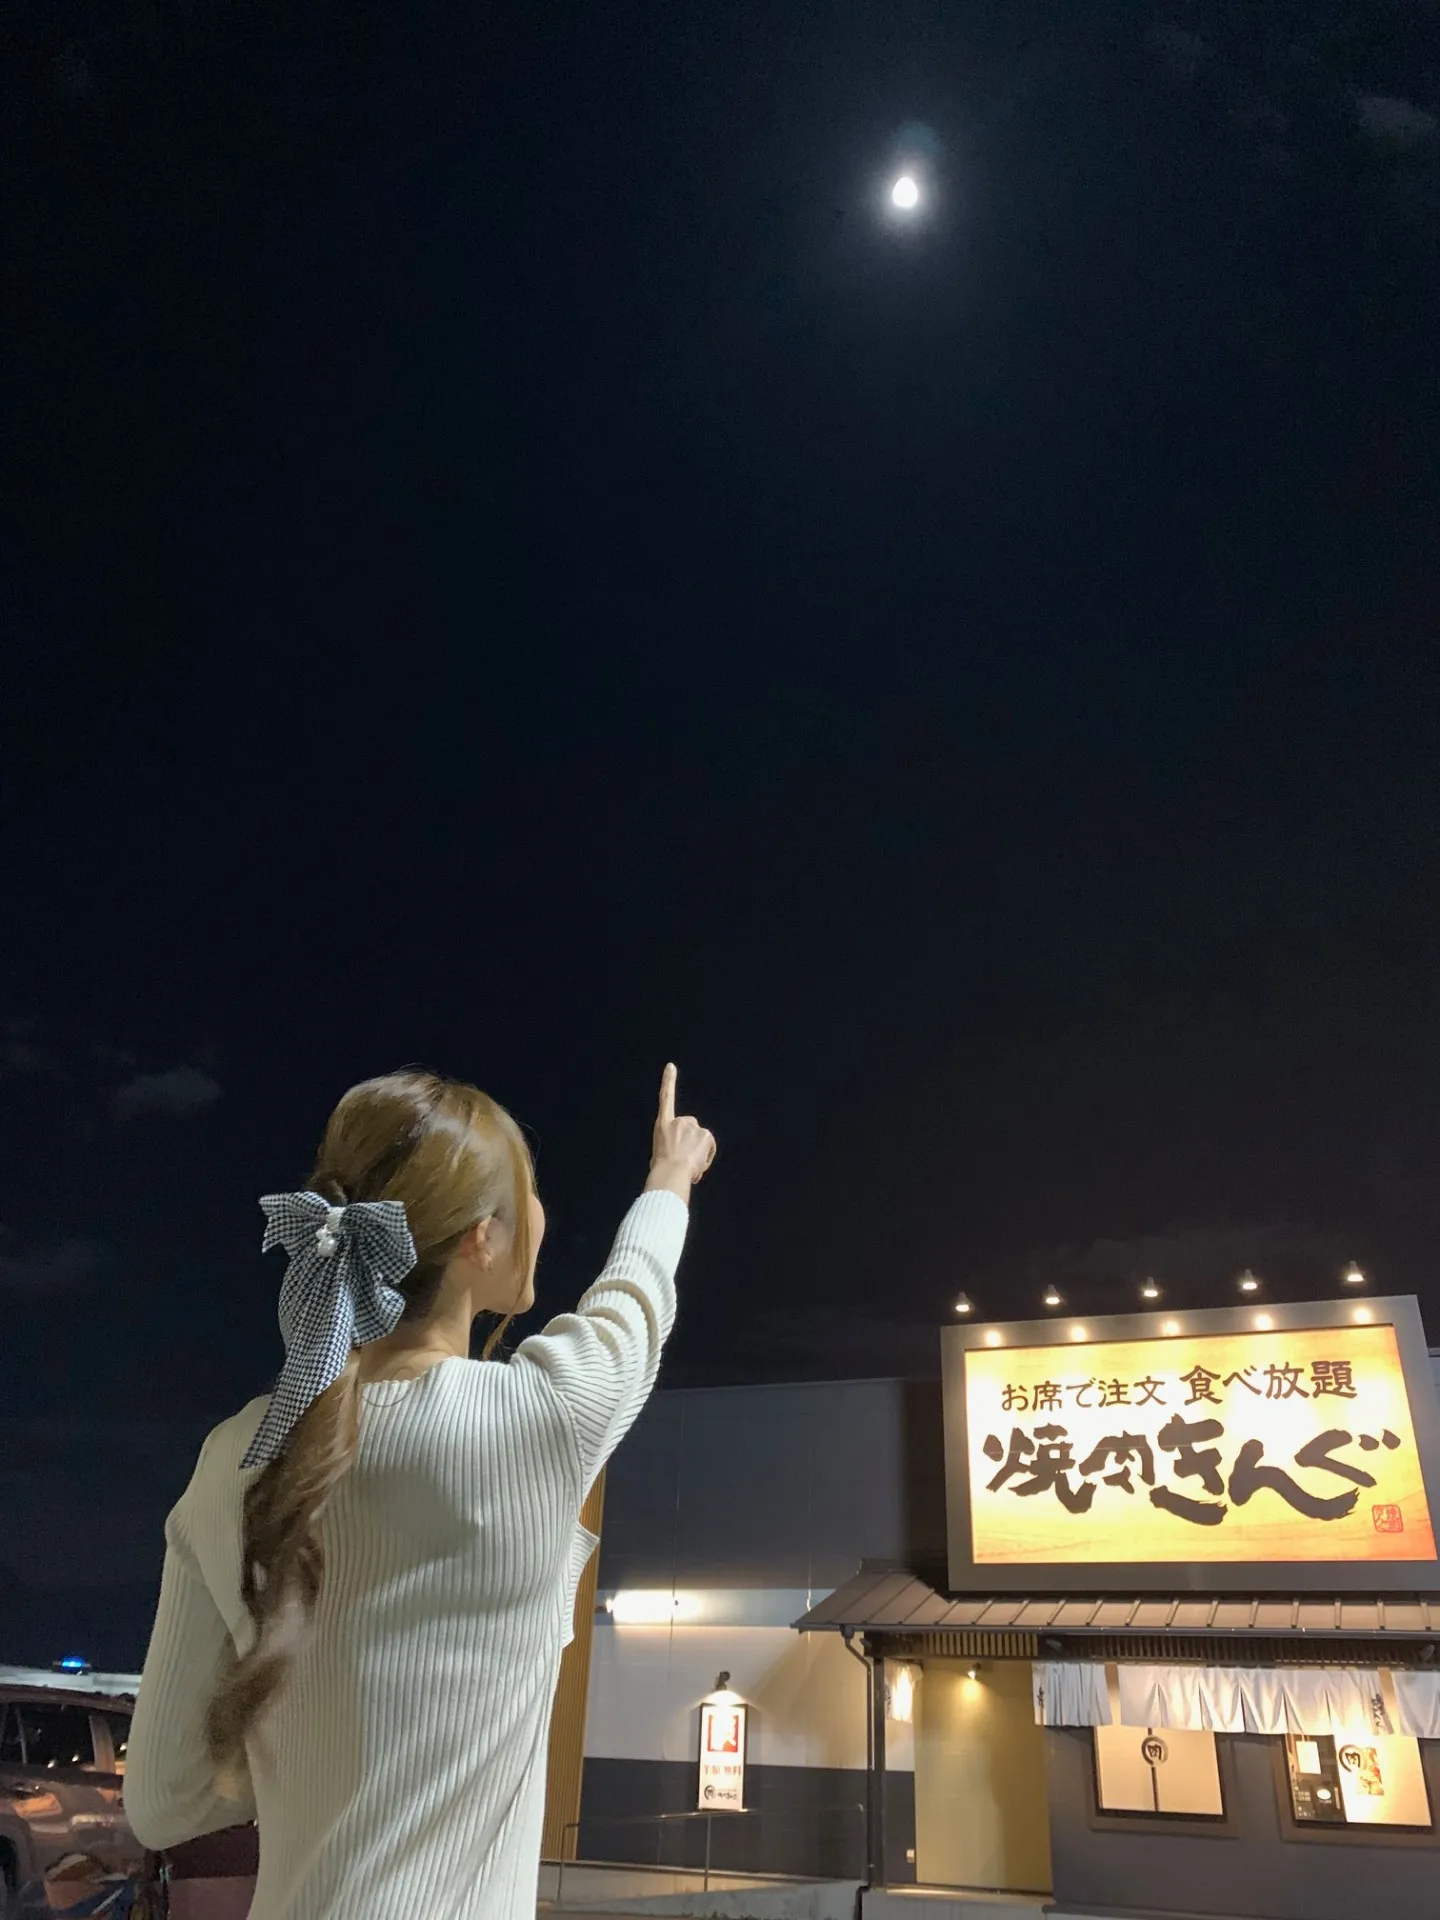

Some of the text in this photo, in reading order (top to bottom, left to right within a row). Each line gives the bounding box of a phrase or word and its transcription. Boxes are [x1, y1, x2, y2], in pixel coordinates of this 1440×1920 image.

[1001, 1360, 1358, 1412] お席で注文 食べ放題
[982, 1413, 1401, 1527] 焼肉きんぐ
